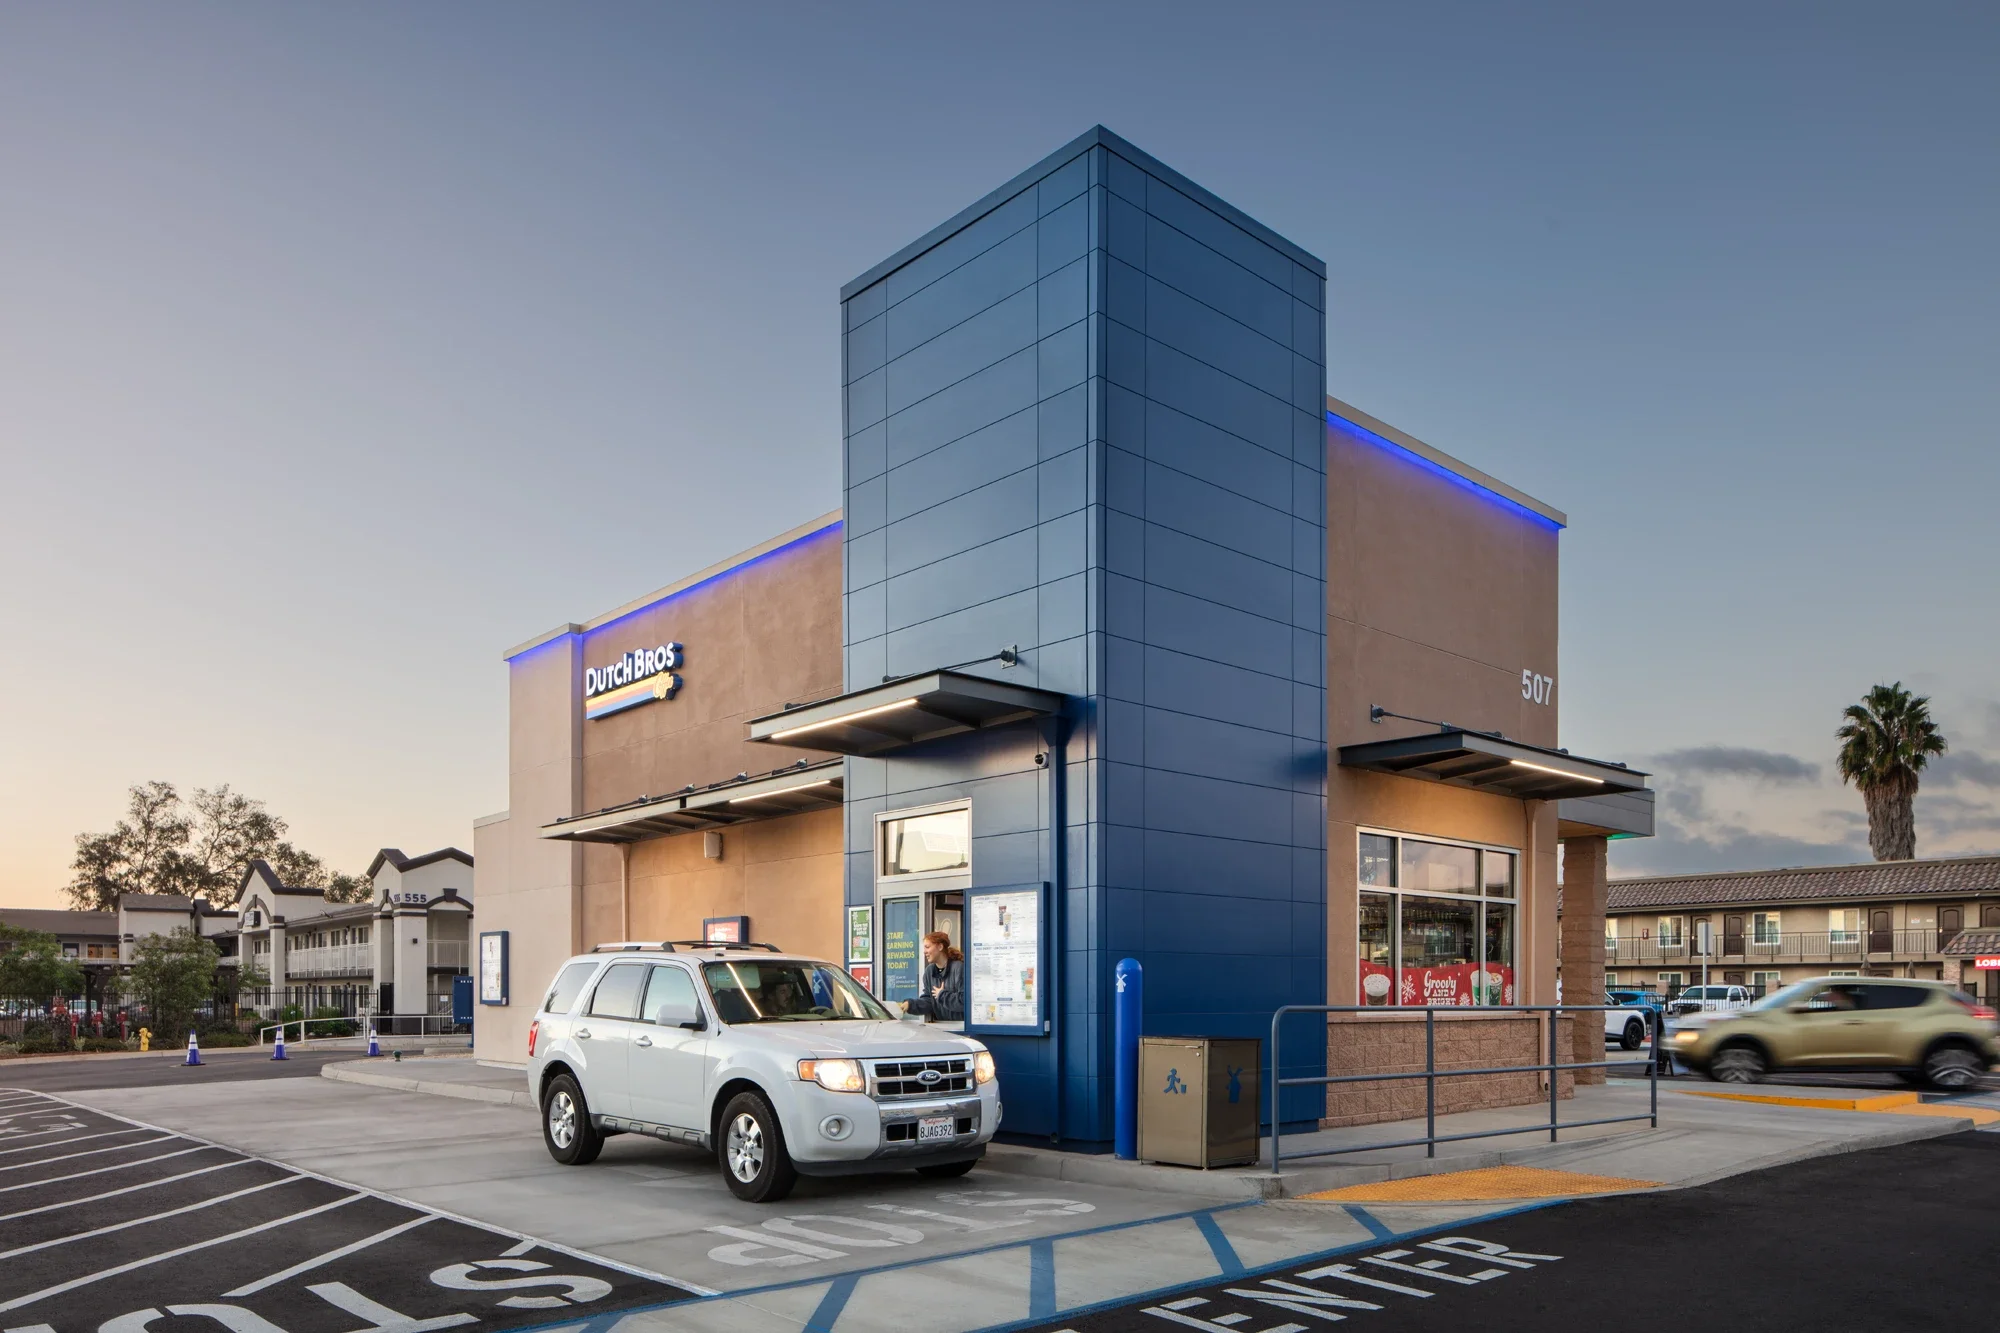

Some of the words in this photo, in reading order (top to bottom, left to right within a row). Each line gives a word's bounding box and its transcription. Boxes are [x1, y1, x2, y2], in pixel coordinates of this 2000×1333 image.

[586, 652, 633, 697] DUTCH
[634, 642, 676, 680] BROS
[1521, 668, 1553, 706] 507
[404, 893, 427, 903] 555
[887, 931, 904, 940] START
[887, 941, 914, 950] EARNING
[887, 951, 915, 960] REWARDS
[887, 961, 909, 970] TODAY!
[1975, 958, 2000, 967] LOB
[1423, 970, 1457, 997] Groovy
[1433, 989, 1449, 997] AND
[1427, 998, 1456, 1006] BRIGHT
[920, 1124, 953, 1138] 8JAG392
[707, 1190, 1096, 1267] STOP
[1140, 1237, 1564, 1333] ENTER
[4, 1260, 613, 1333] STO
